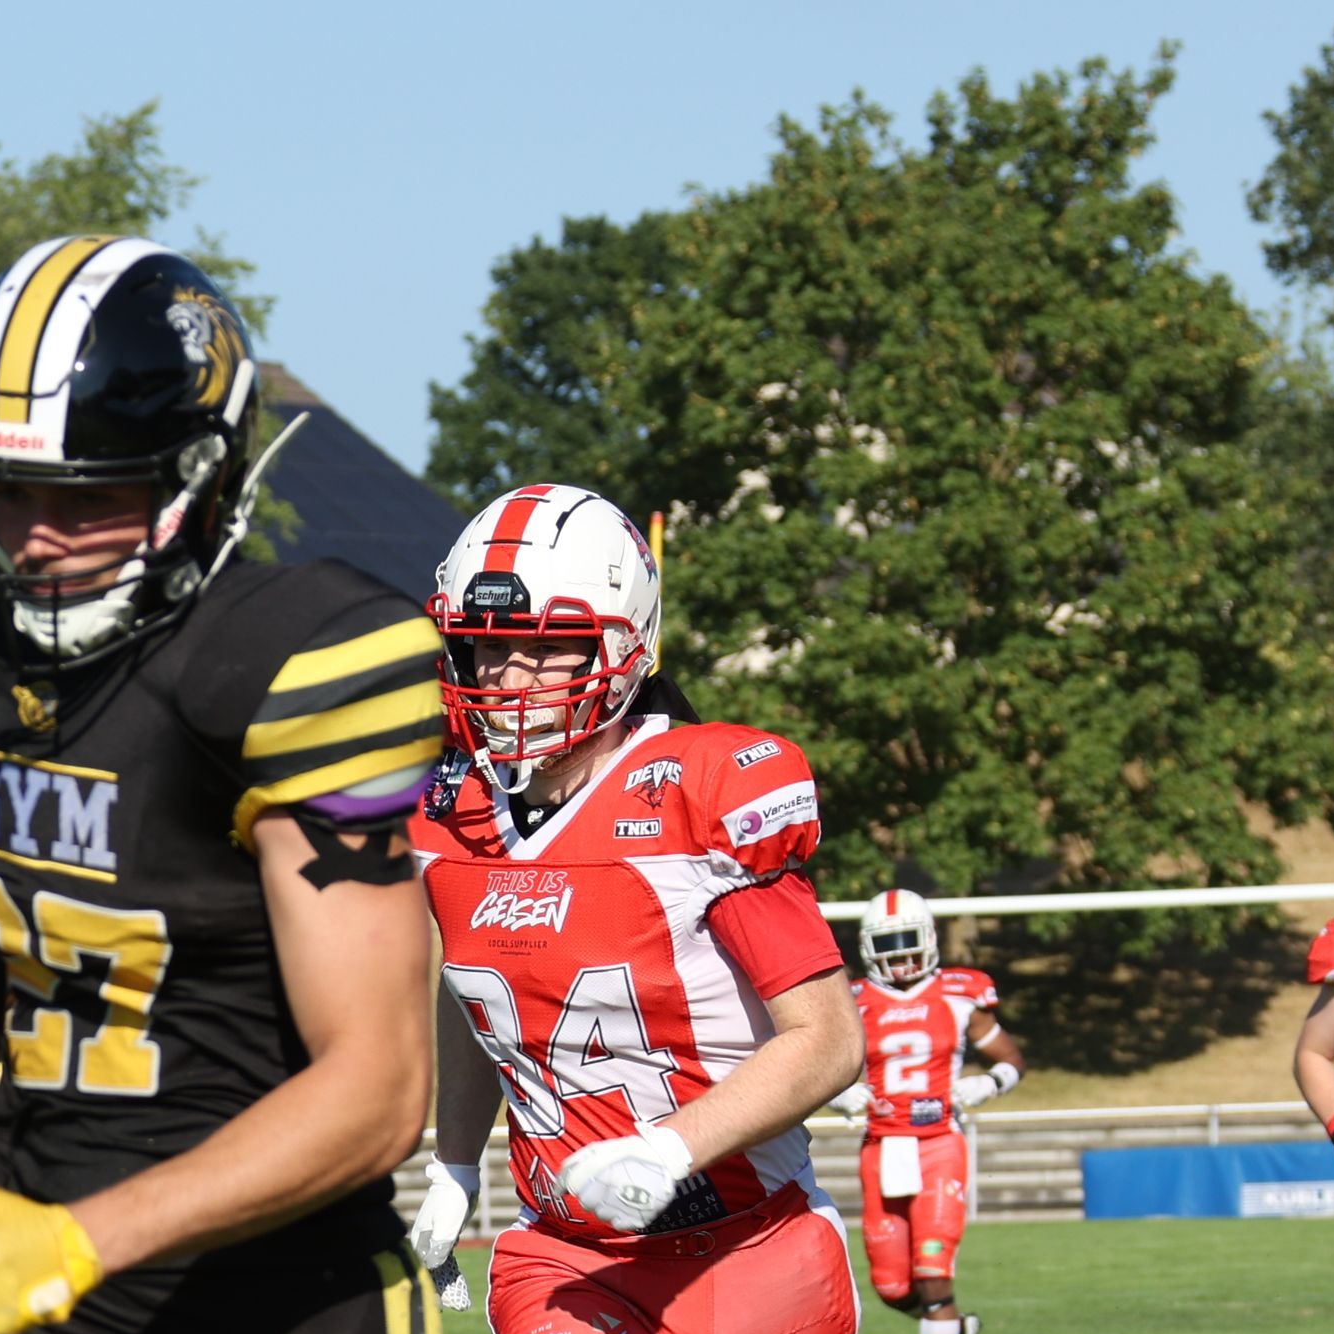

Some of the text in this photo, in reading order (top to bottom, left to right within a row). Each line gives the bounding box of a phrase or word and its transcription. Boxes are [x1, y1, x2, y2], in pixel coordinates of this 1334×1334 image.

[735, 741, 779, 766] TNKD
[624, 760, 684, 792] DEVILS
[616, 822, 660, 836] TNKD
[486, 870, 568, 894] THIS IS
[469, 886, 574, 934] GELSEN
[441, 961, 680, 1139] 84
[878, 1030, 933, 1095] 2
